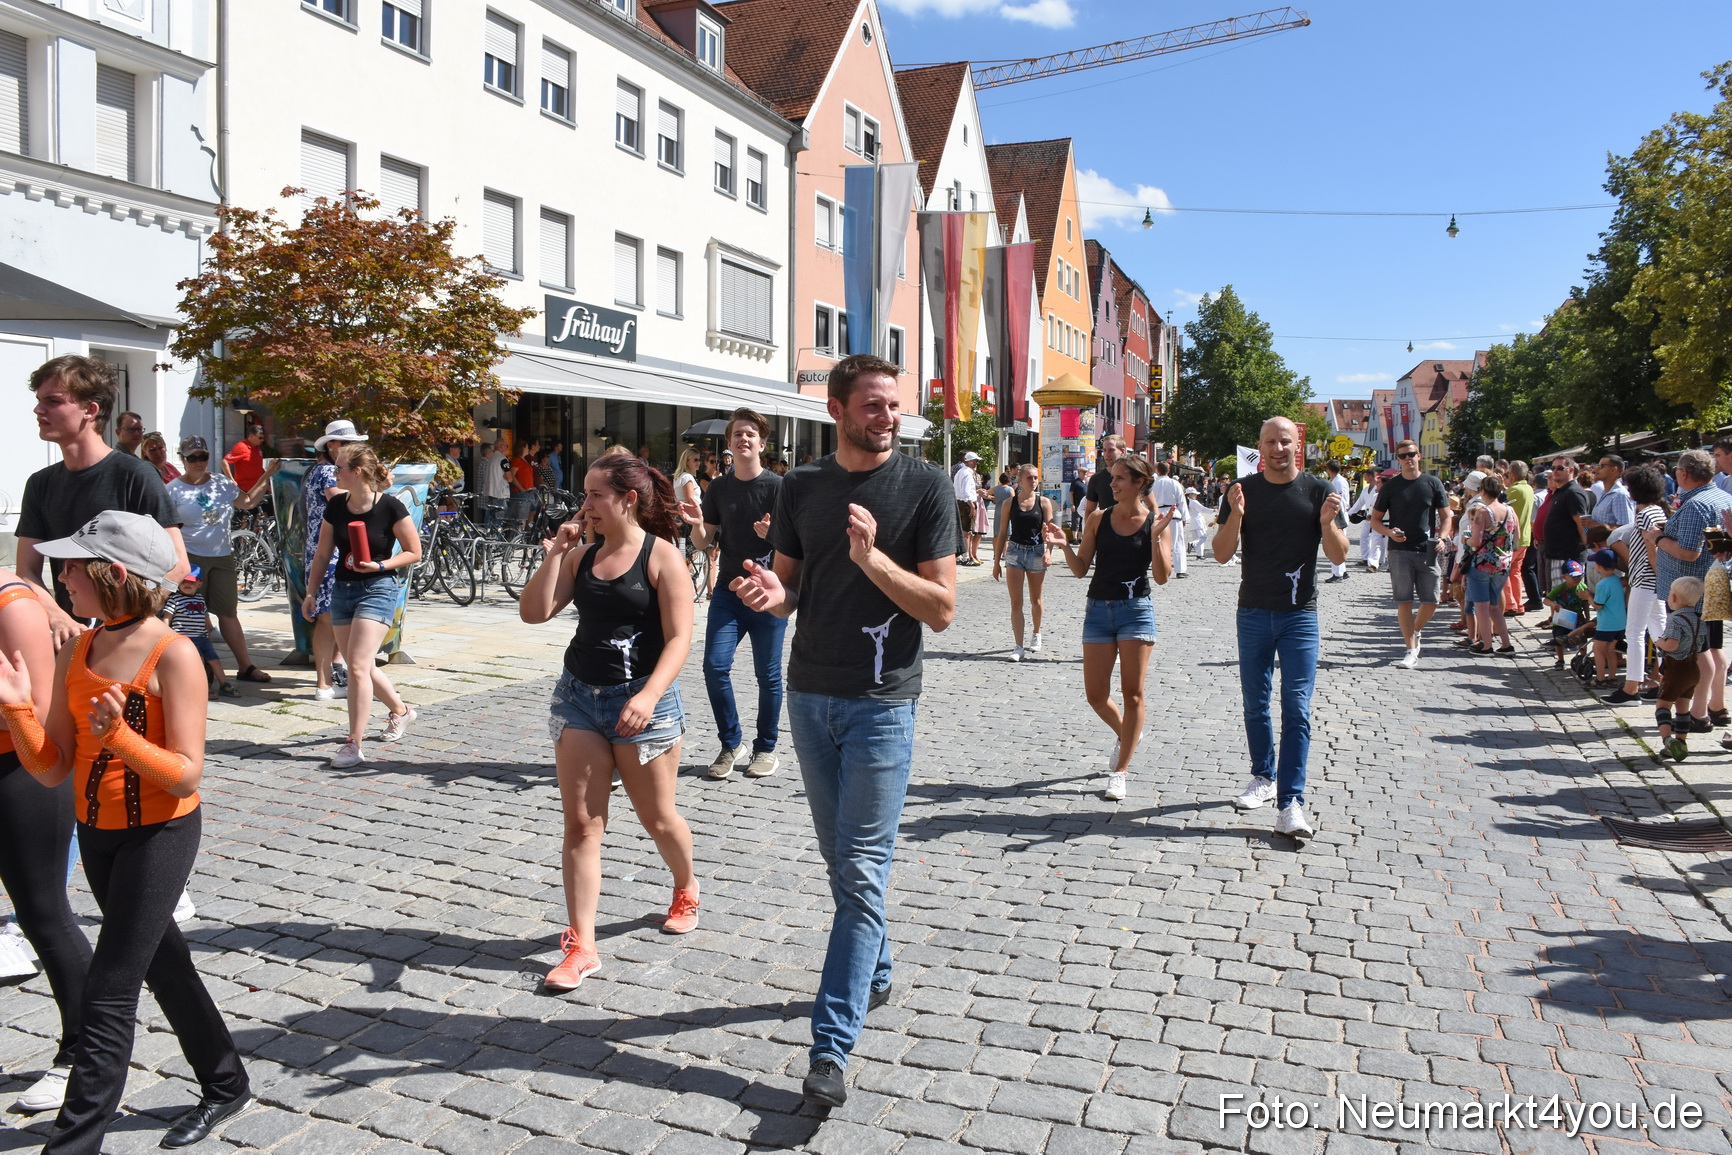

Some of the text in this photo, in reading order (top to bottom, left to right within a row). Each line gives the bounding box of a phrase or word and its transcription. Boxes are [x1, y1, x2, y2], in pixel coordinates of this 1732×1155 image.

[552, 305, 636, 354] frühauf
[799, 372, 829, 382] sutor
[1151, 365, 1162, 428] HOTEL
